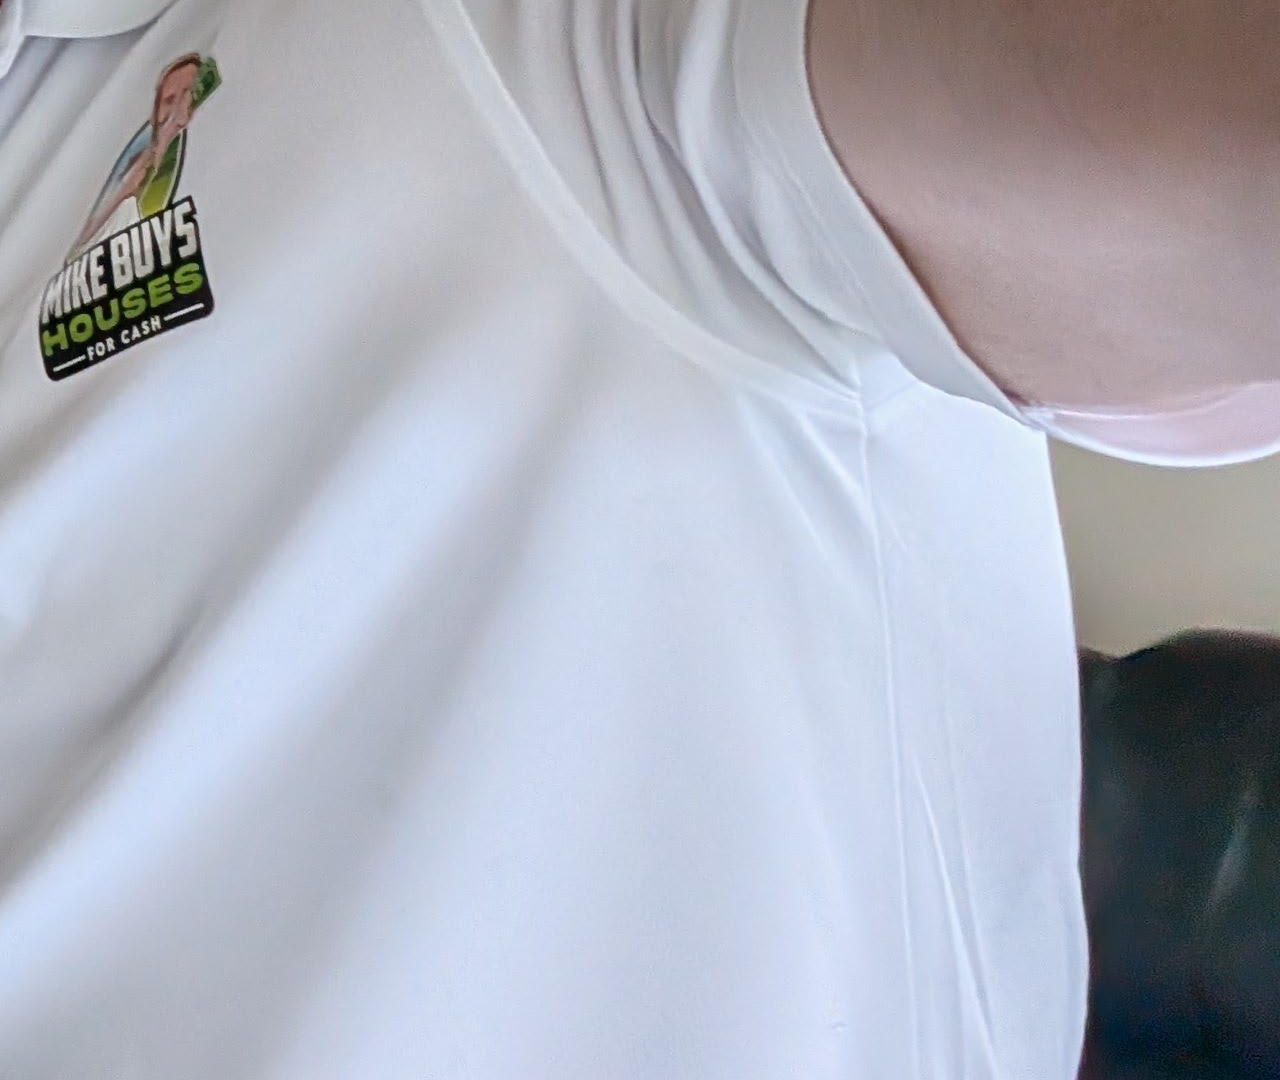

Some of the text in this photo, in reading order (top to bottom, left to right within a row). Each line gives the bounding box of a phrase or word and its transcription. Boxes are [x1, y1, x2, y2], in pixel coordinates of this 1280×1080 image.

[42, 201, 197, 324] MIKE BUYS
[42, 262, 204, 357] HOUSES
[87, 317, 163, 362] FOR CASH
